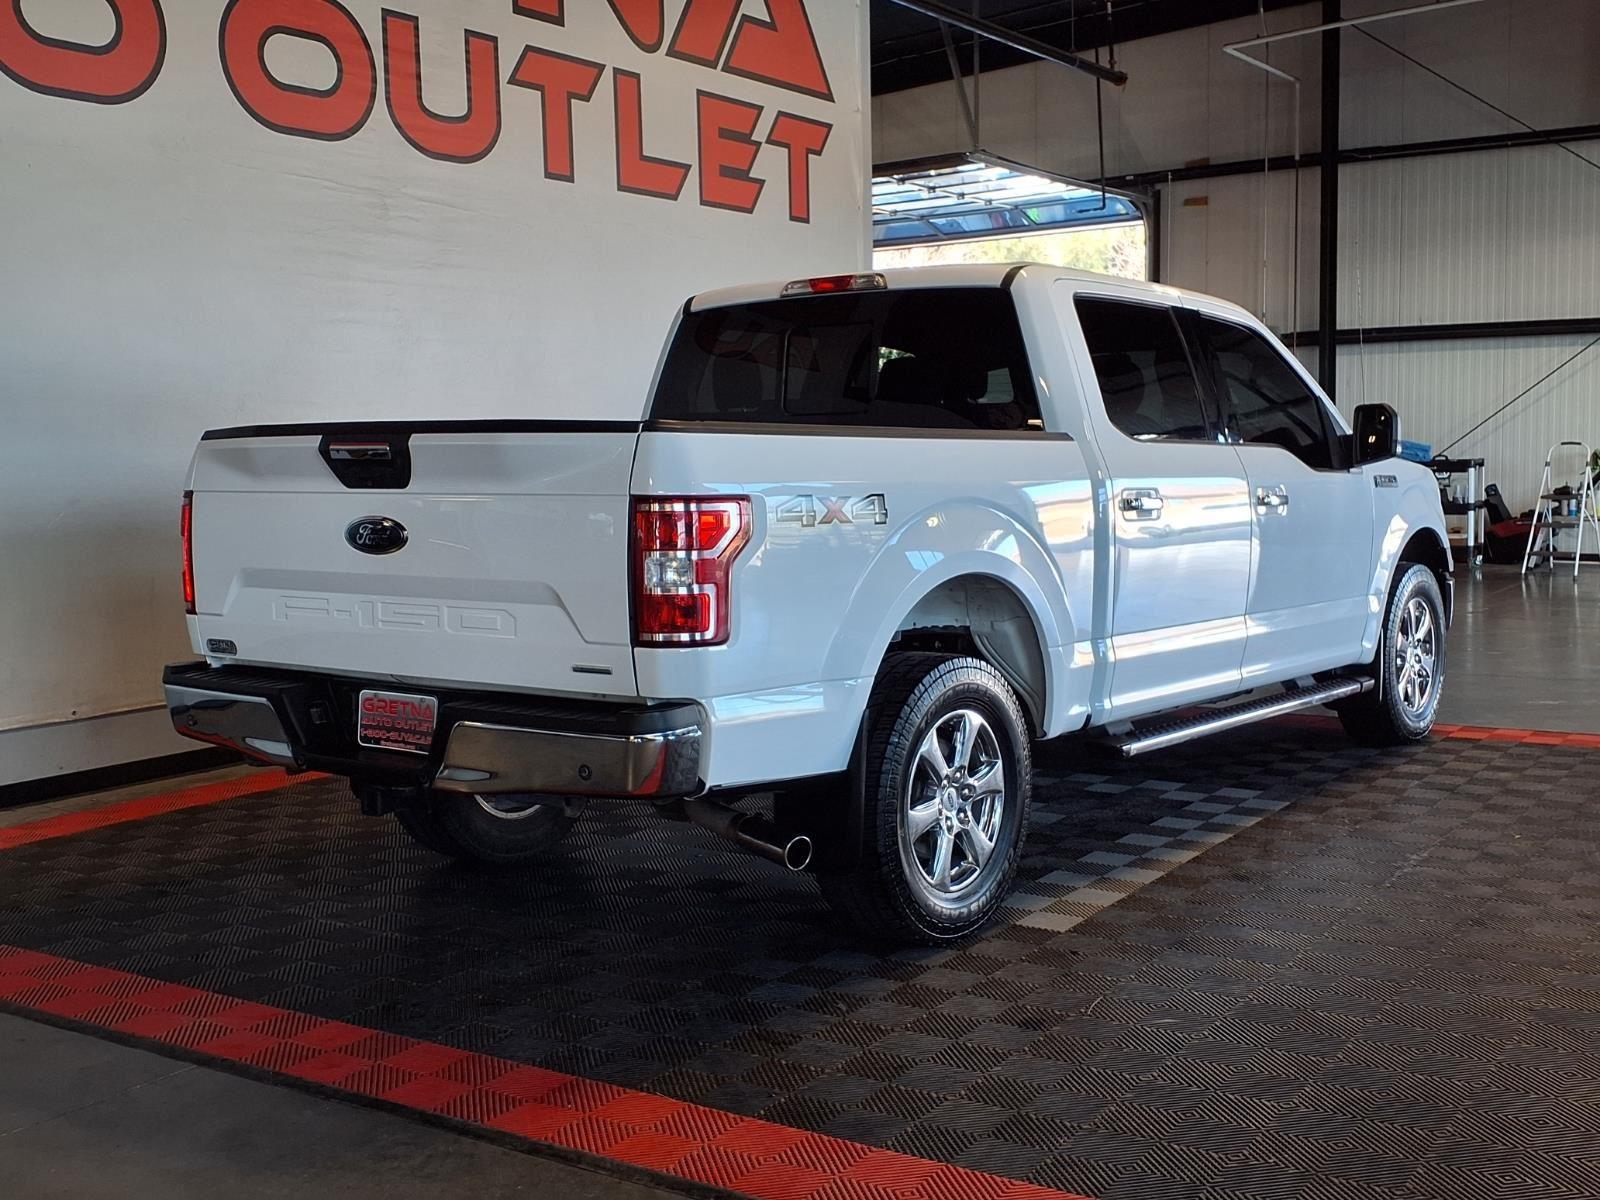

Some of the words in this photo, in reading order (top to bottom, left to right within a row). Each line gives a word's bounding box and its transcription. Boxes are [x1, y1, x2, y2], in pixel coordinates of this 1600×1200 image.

[218, 0, 834, 224] OUTLET
[272, 594, 517, 639] F-150
[361, 716, 393, 727] AUTO
[395, 719, 433, 732] OUTLET
[363, 697, 433, 719] GRETNA
